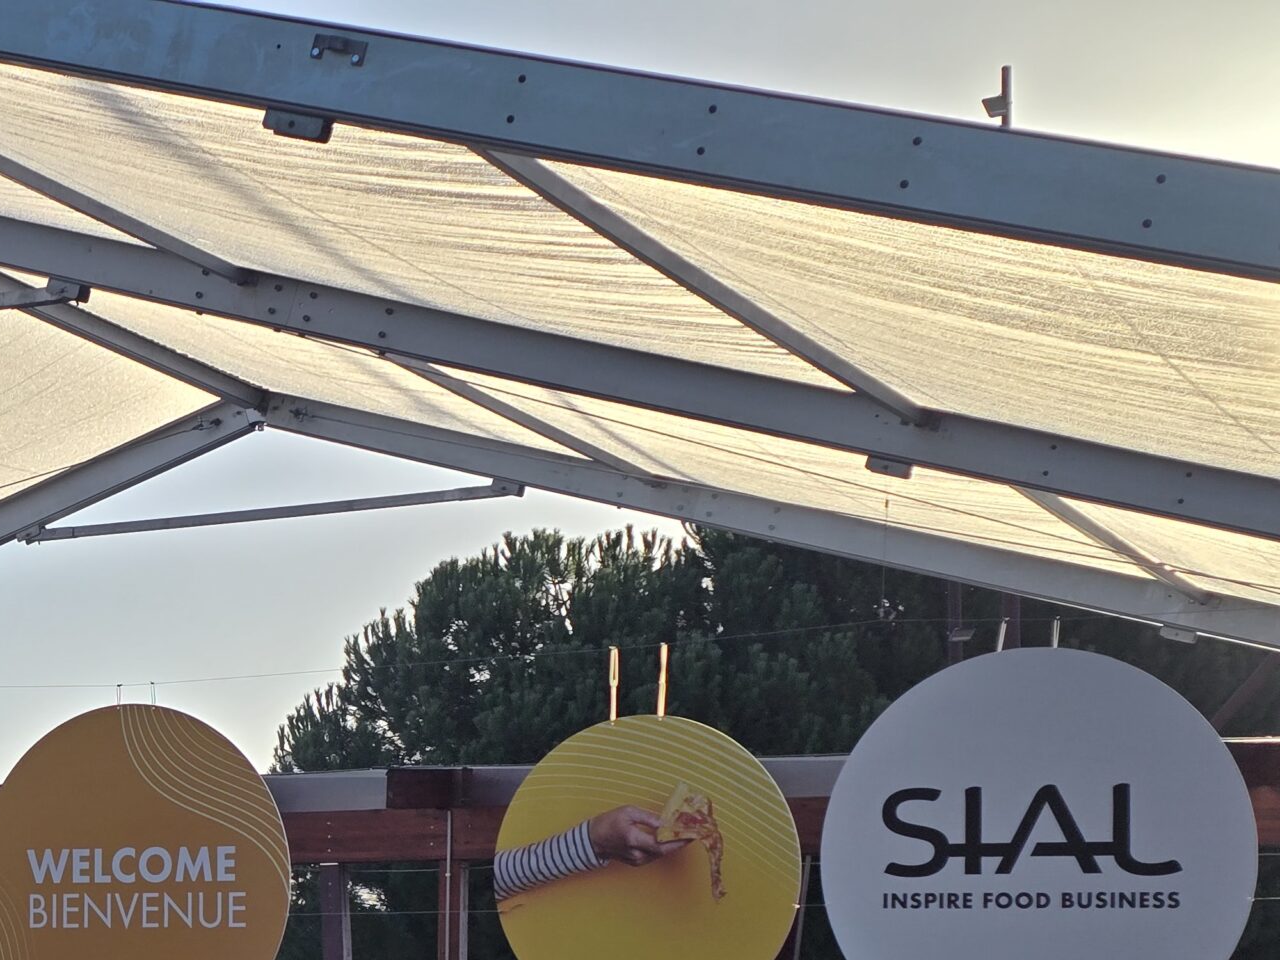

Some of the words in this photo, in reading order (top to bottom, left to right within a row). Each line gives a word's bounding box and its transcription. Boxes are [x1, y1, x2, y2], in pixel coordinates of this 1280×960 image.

[882, 783, 1183, 878] SIAL
[27, 846, 236, 884] WELCOME
[29, 892, 246, 928] BIENVENUE
[882, 892, 973, 909] INSPIRE
[983, 892, 1051, 909] FOOD
[1061, 891, 1181, 909] BUSINESS
